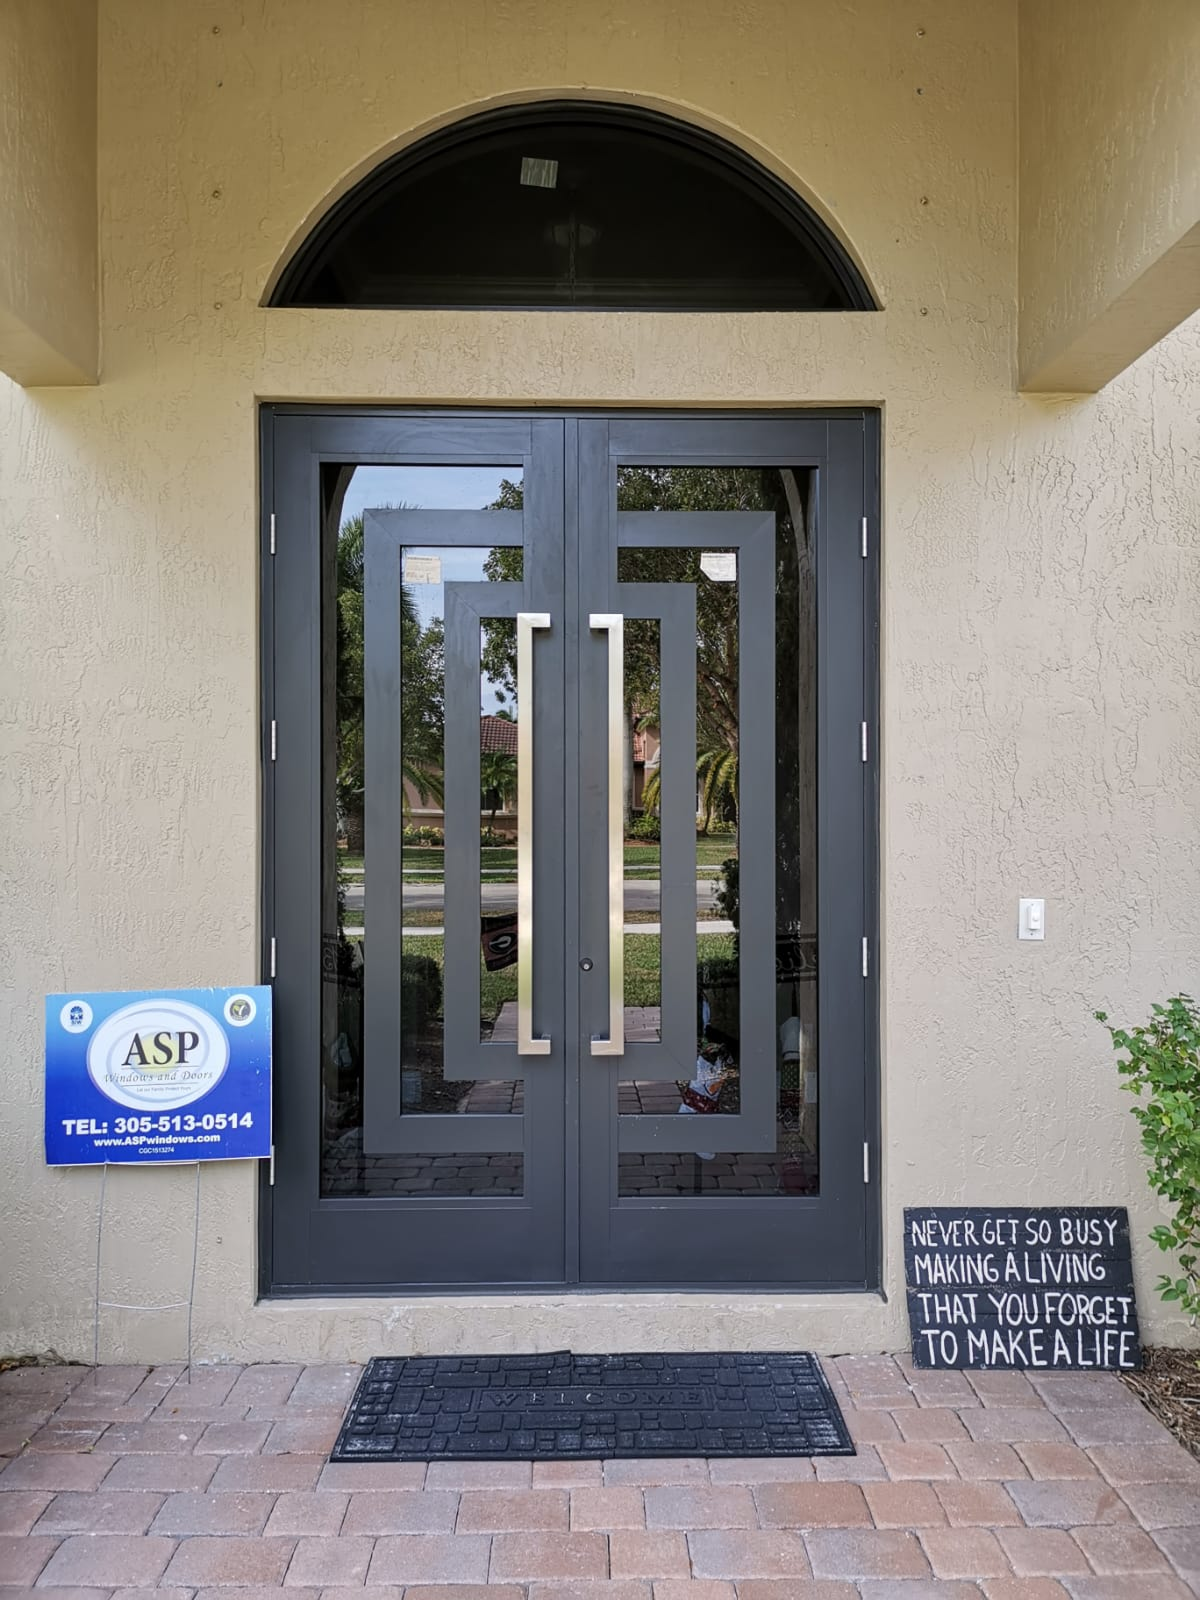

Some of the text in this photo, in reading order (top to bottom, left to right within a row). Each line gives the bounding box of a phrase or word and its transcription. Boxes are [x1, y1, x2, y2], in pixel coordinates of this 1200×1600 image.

[121, 1031, 199, 1066] ASP
[104, 1070, 213, 1084] Windows and Doors
[62, 1112, 254, 1136] TEL: 305-513-0514
[94, 1133, 221, 1147] www.ASPwindows.com
[911, 1217, 1118, 1247] NEVER GET SO BUSY
[914, 1251, 1106, 1285] MAKING A LIVING
[917, 1292, 1132, 1326] THAT YOU FORGET
[920, 1328, 1135, 1367] TO MAKE A LIFE
